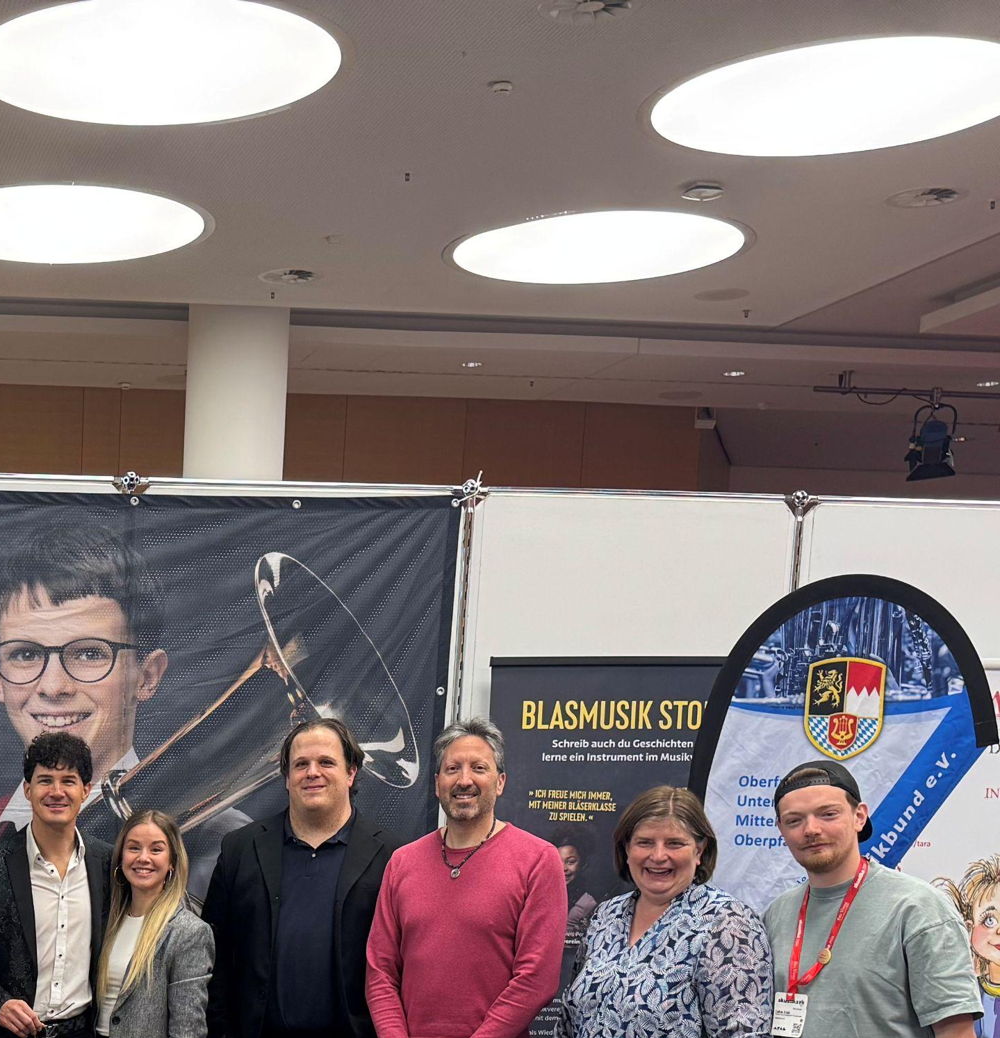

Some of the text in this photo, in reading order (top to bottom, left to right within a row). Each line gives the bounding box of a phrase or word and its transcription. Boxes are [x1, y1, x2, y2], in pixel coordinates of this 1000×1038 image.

[521, 700, 708, 730] BLASMUSIK STO
[552, 738, 694, 748] Schreib auch du Geschichten
[541, 752, 568, 762] lerne
[569, 752, 585, 762] ein
[586, 752, 644, 762] Instrument
[645, 752, 659, 762] im
[926, 752, 956, 788] e.V.
[738, 775, 782, 788] Oberf
[535, 790, 547, 798] ICH
[548, 790, 569, 799] FREUE
[569, 790, 587, 800] MICH
[588, 791, 613, 802] IMMER,
[528, 800, 617, 812] MIT MEINER BLÄSERKLASSE
[549, 812, 558, 821] ZU
[559, 812, 588, 822] SPIELEN.
